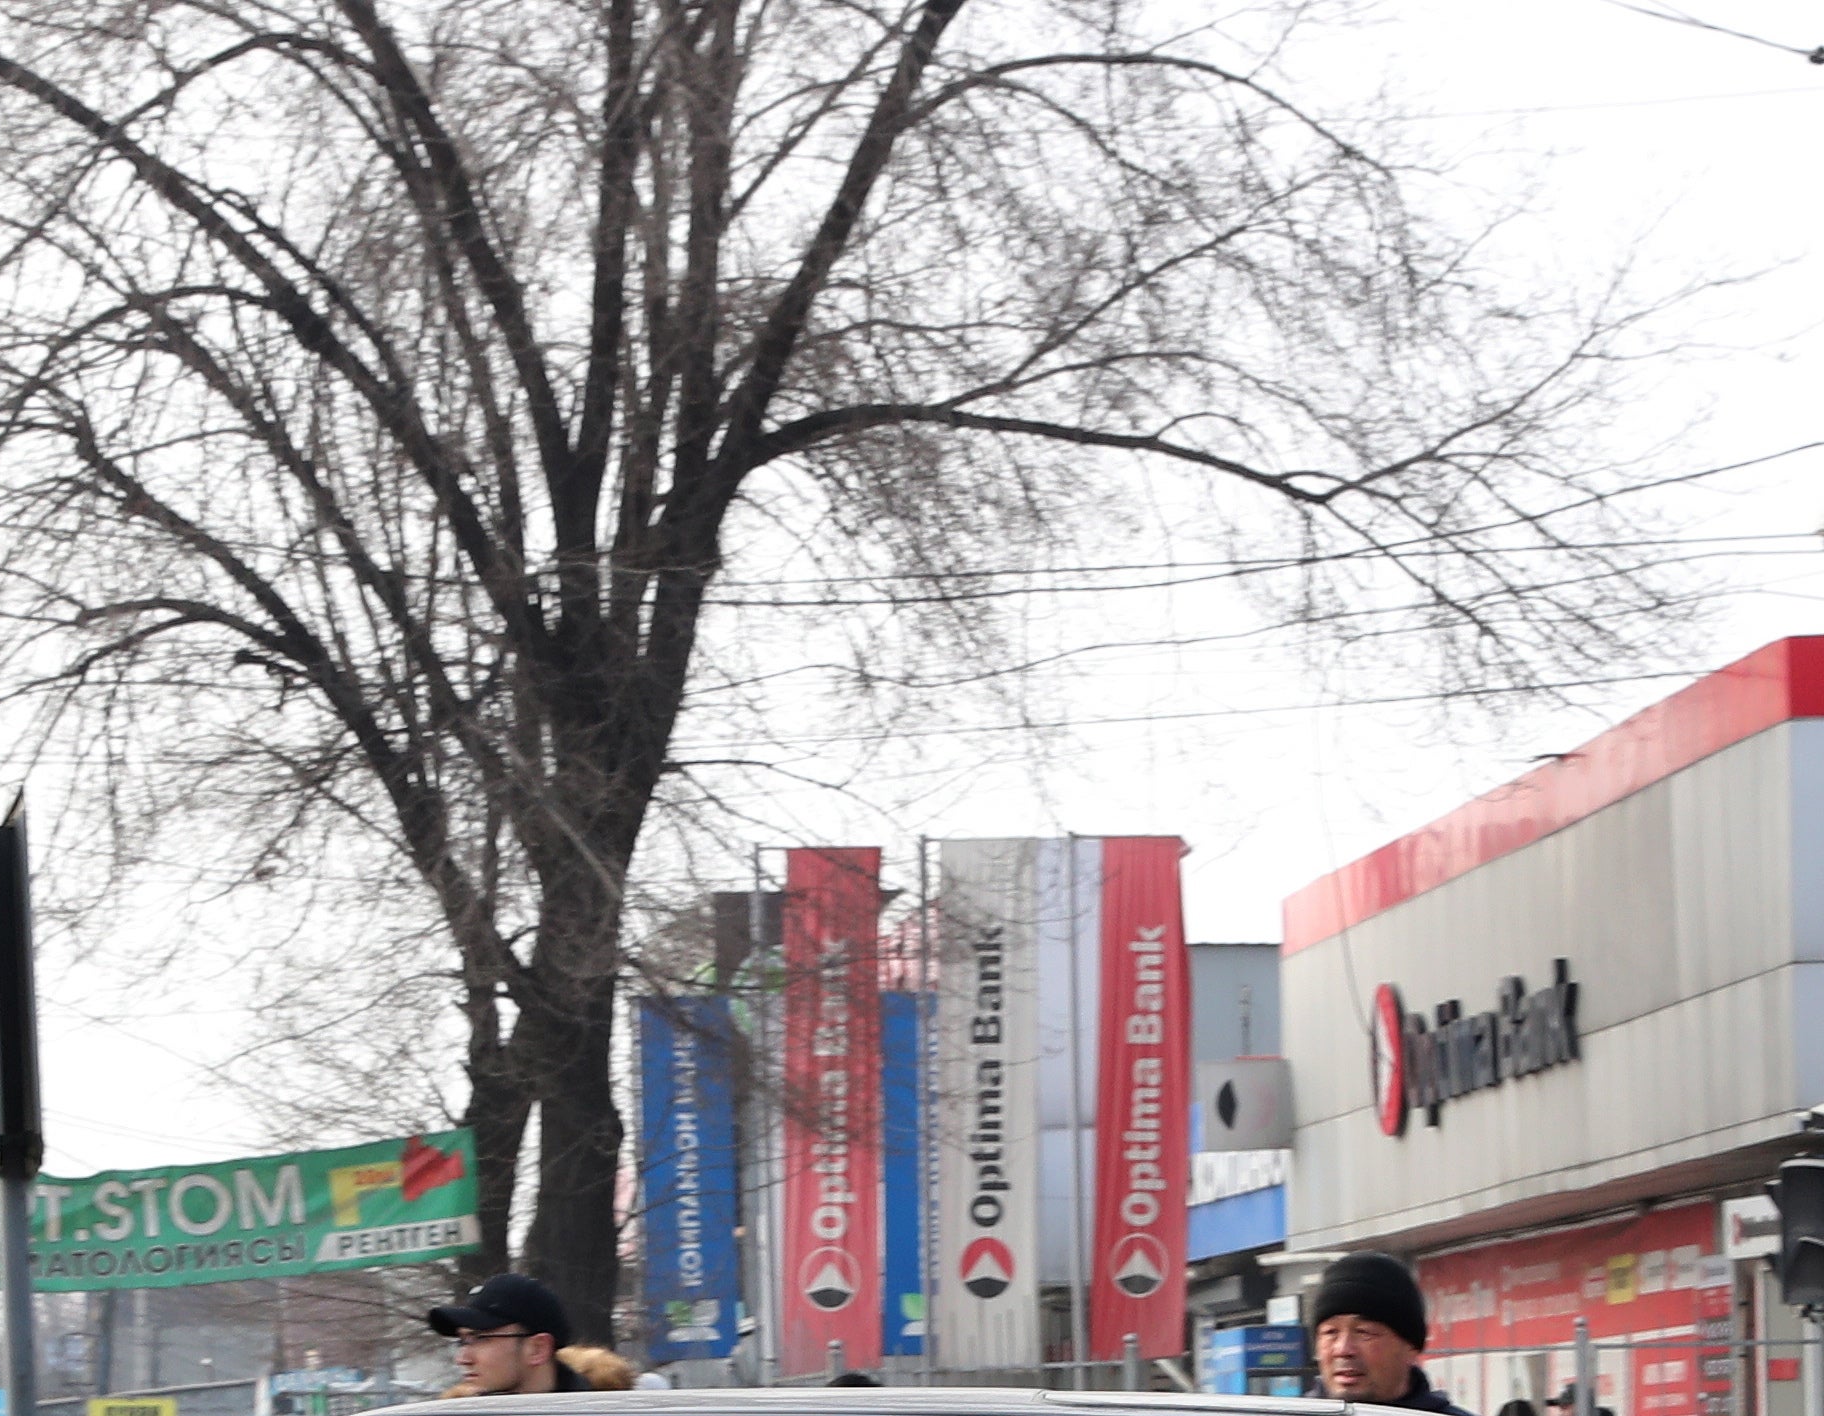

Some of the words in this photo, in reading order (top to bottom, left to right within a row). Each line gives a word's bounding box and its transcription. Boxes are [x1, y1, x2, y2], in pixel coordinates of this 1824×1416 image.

[971, 926, 1004, 1045] Bank
[1125, 924, 1166, 1045] Bank
[969, 1059, 1010, 1228] Optima
[1120, 1057, 1167, 1227] Optima
[337, 1222, 463, 1258] РЕНТГЕН
